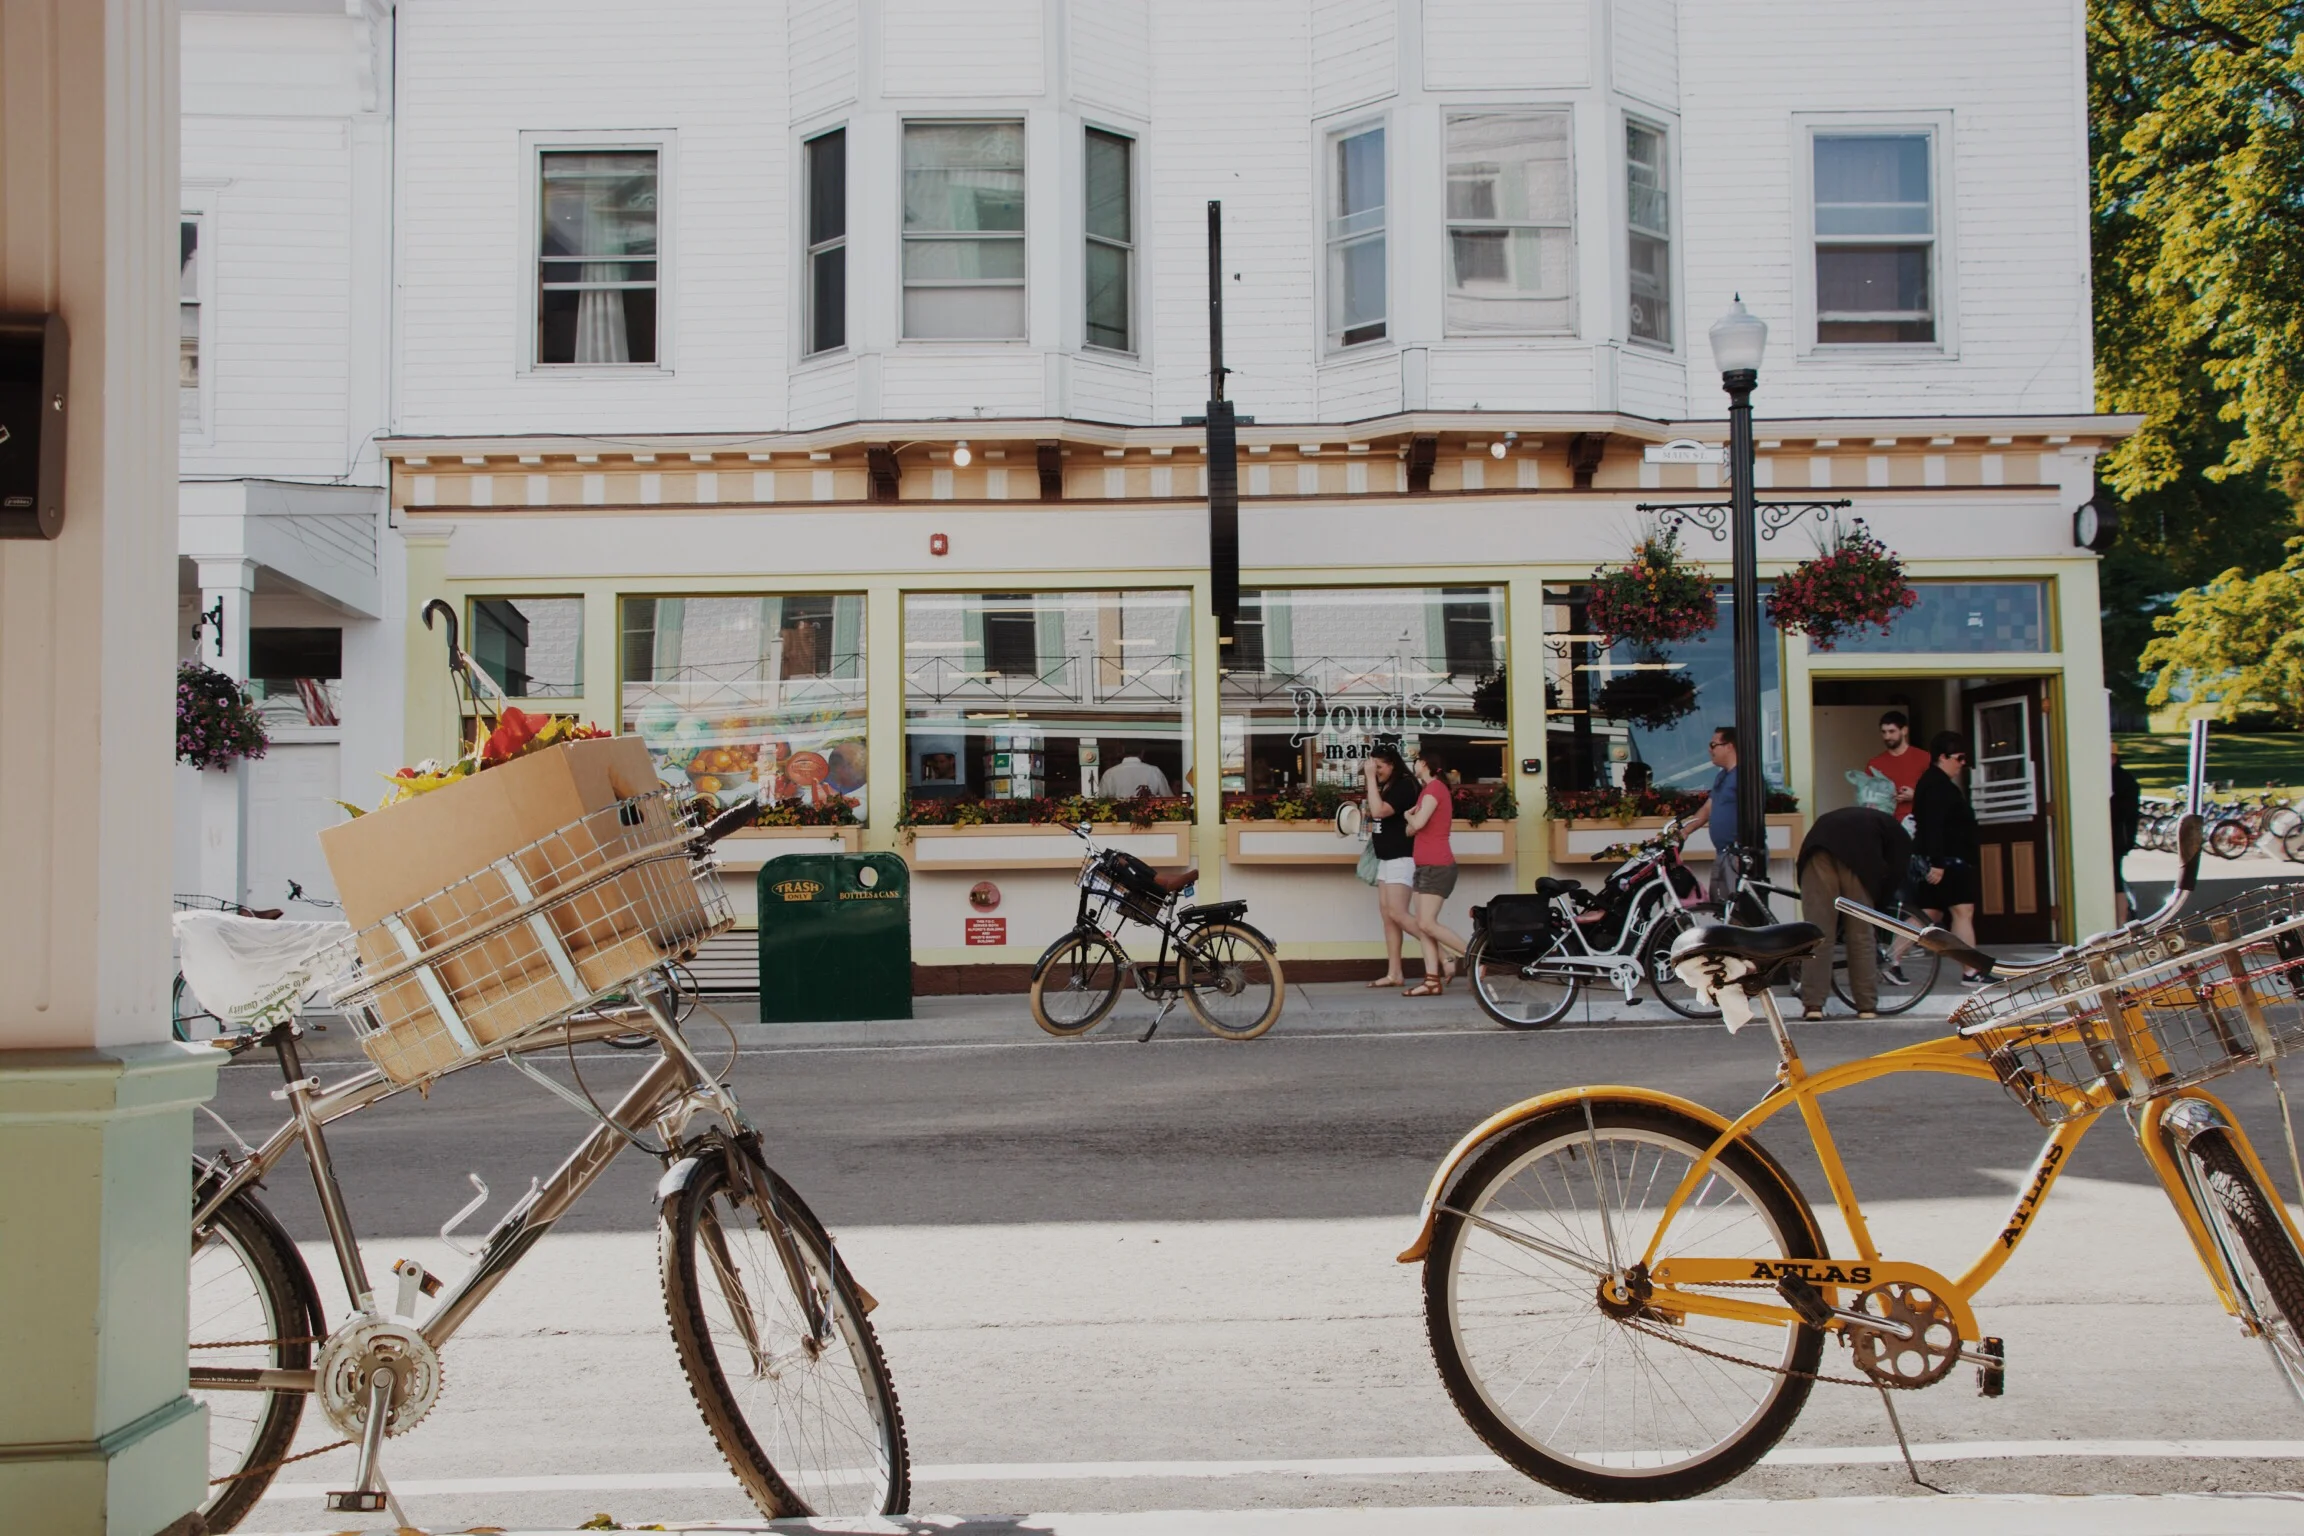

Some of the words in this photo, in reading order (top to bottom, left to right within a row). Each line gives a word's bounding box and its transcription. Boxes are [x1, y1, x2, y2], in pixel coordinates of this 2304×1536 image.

[1663, 451, 1691, 459] MAIN
[1285, 685, 1445, 747] Doud's
[776, 881, 819, 893] TRASH
[839, 890, 873, 900] BOTTLES
[879, 890, 900, 899] CANS
[228, 1000, 258, 1014] Quality
[1999, 1143, 2064, 1249] ATLAS
[1750, 1262, 1872, 1284] ATLAS
